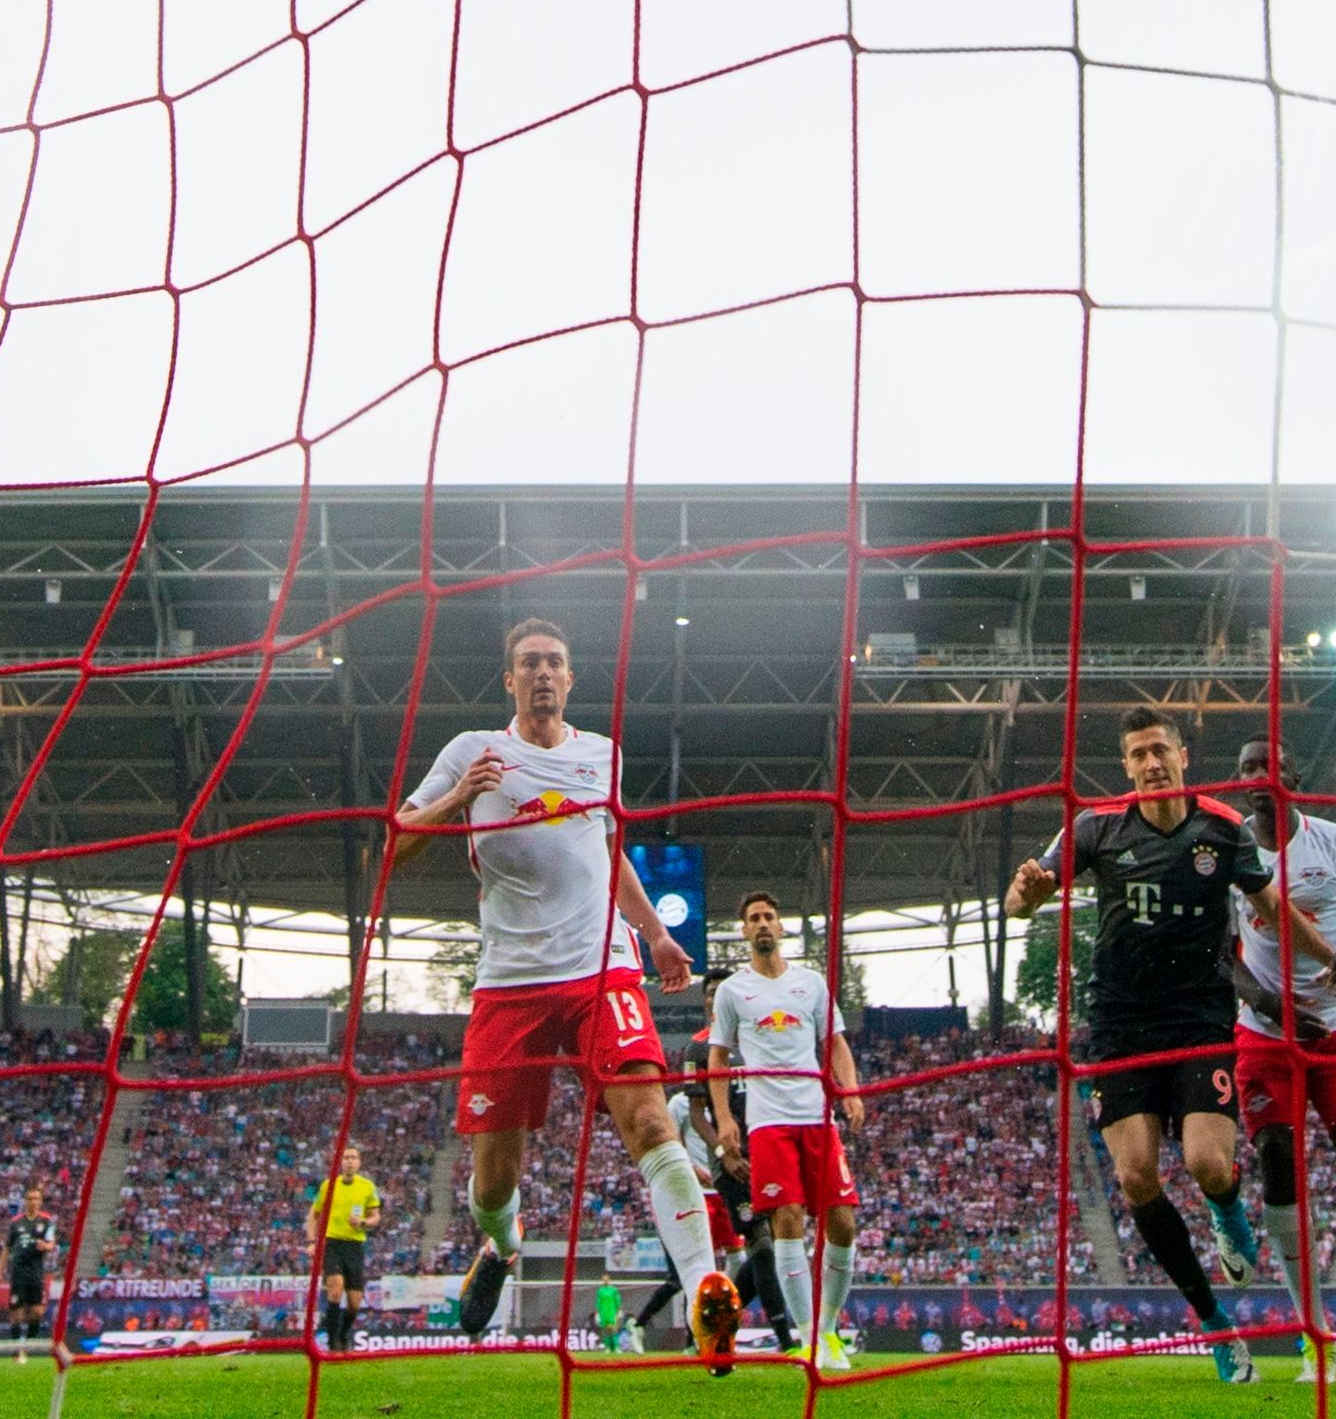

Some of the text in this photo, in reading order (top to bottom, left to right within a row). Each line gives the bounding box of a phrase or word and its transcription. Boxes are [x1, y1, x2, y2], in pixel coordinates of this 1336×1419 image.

[607, 991, 644, 1031] 13
[1212, 1069, 1232, 1105] 9
[482, 1330, 518, 1349] die
[1090, 1331, 1126, 1352] die
